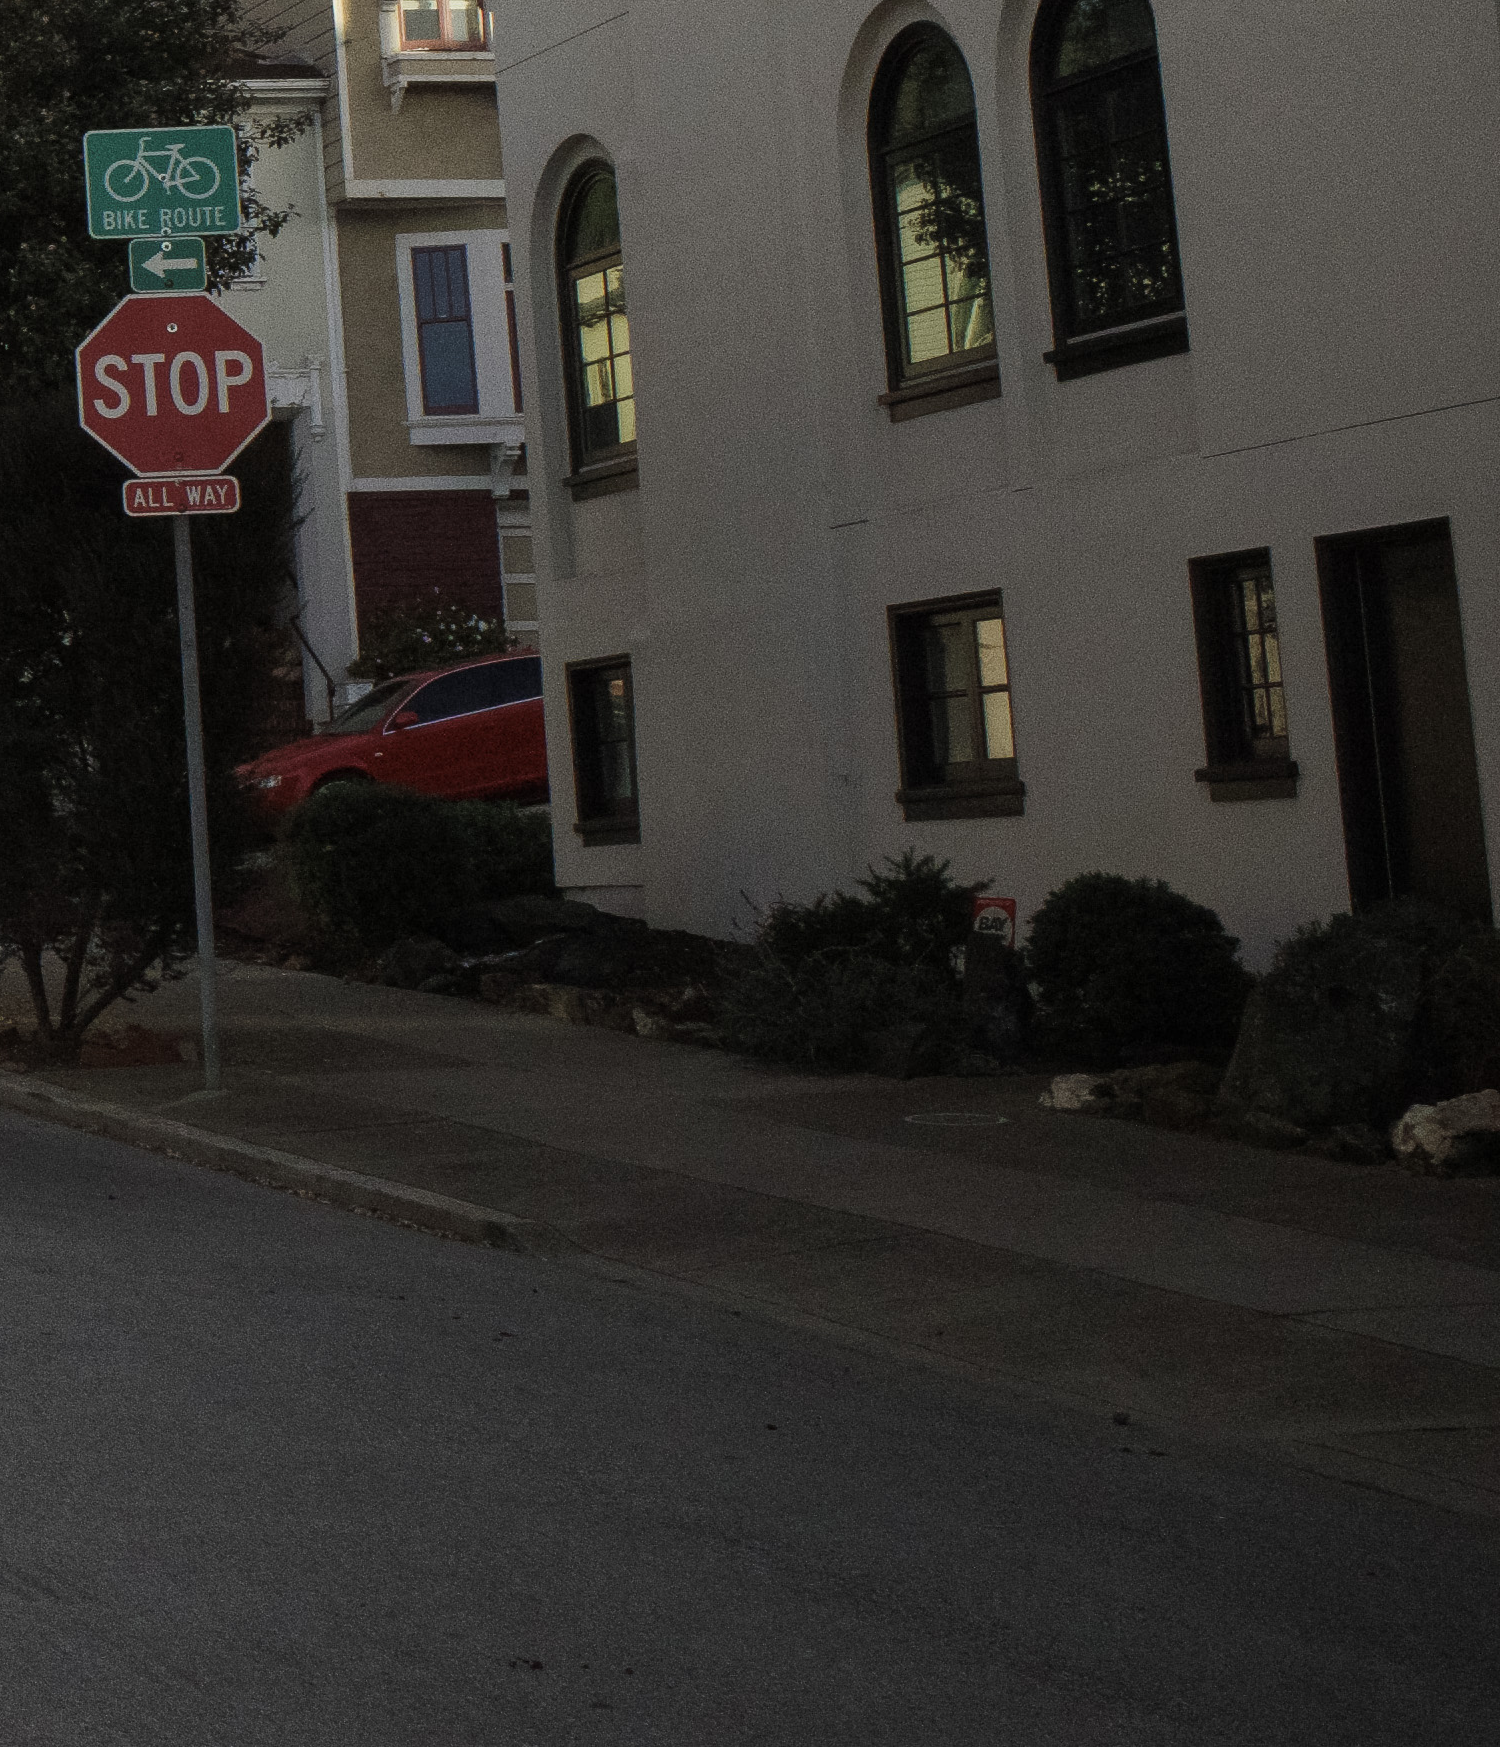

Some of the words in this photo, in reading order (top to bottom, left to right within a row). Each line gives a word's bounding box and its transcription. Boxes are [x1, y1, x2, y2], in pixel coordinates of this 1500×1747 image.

[103, 209, 150, 231] BIKE
[160, 206, 227, 229] ROUTE
[93, 350, 253, 419] STOP
[133, 487, 174, 507] ALL
[186, 484, 230, 505] WAY
[978, 915, 1010, 932] BAY
